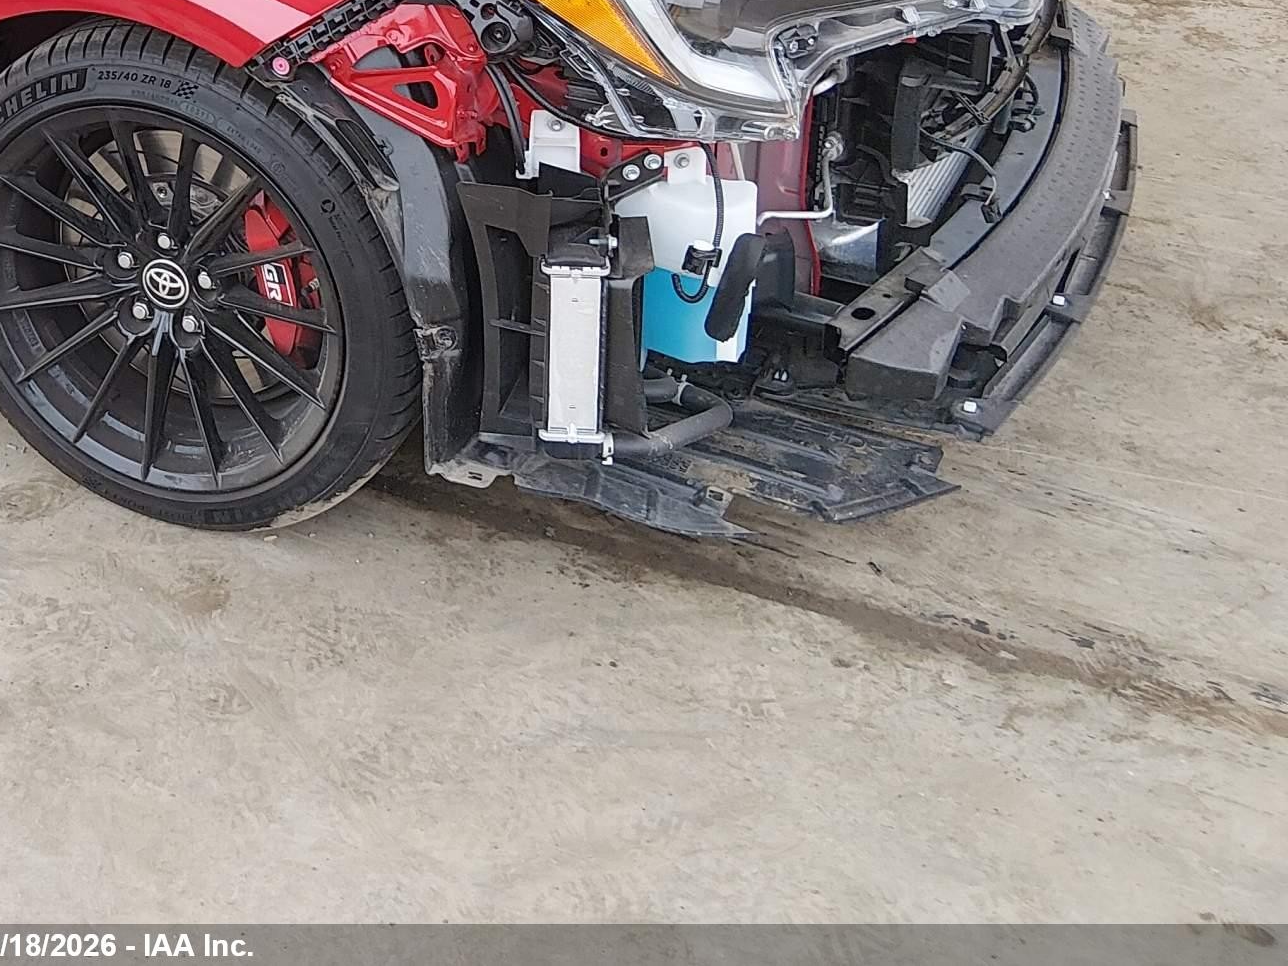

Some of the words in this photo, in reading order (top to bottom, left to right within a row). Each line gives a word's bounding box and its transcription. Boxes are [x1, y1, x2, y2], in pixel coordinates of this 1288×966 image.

[97, 70, 138, 82] 235/40
[141, 74, 157, 86] ZR
[160, 78, 172, 89] 18
[264, 263, 282, 301] GR
